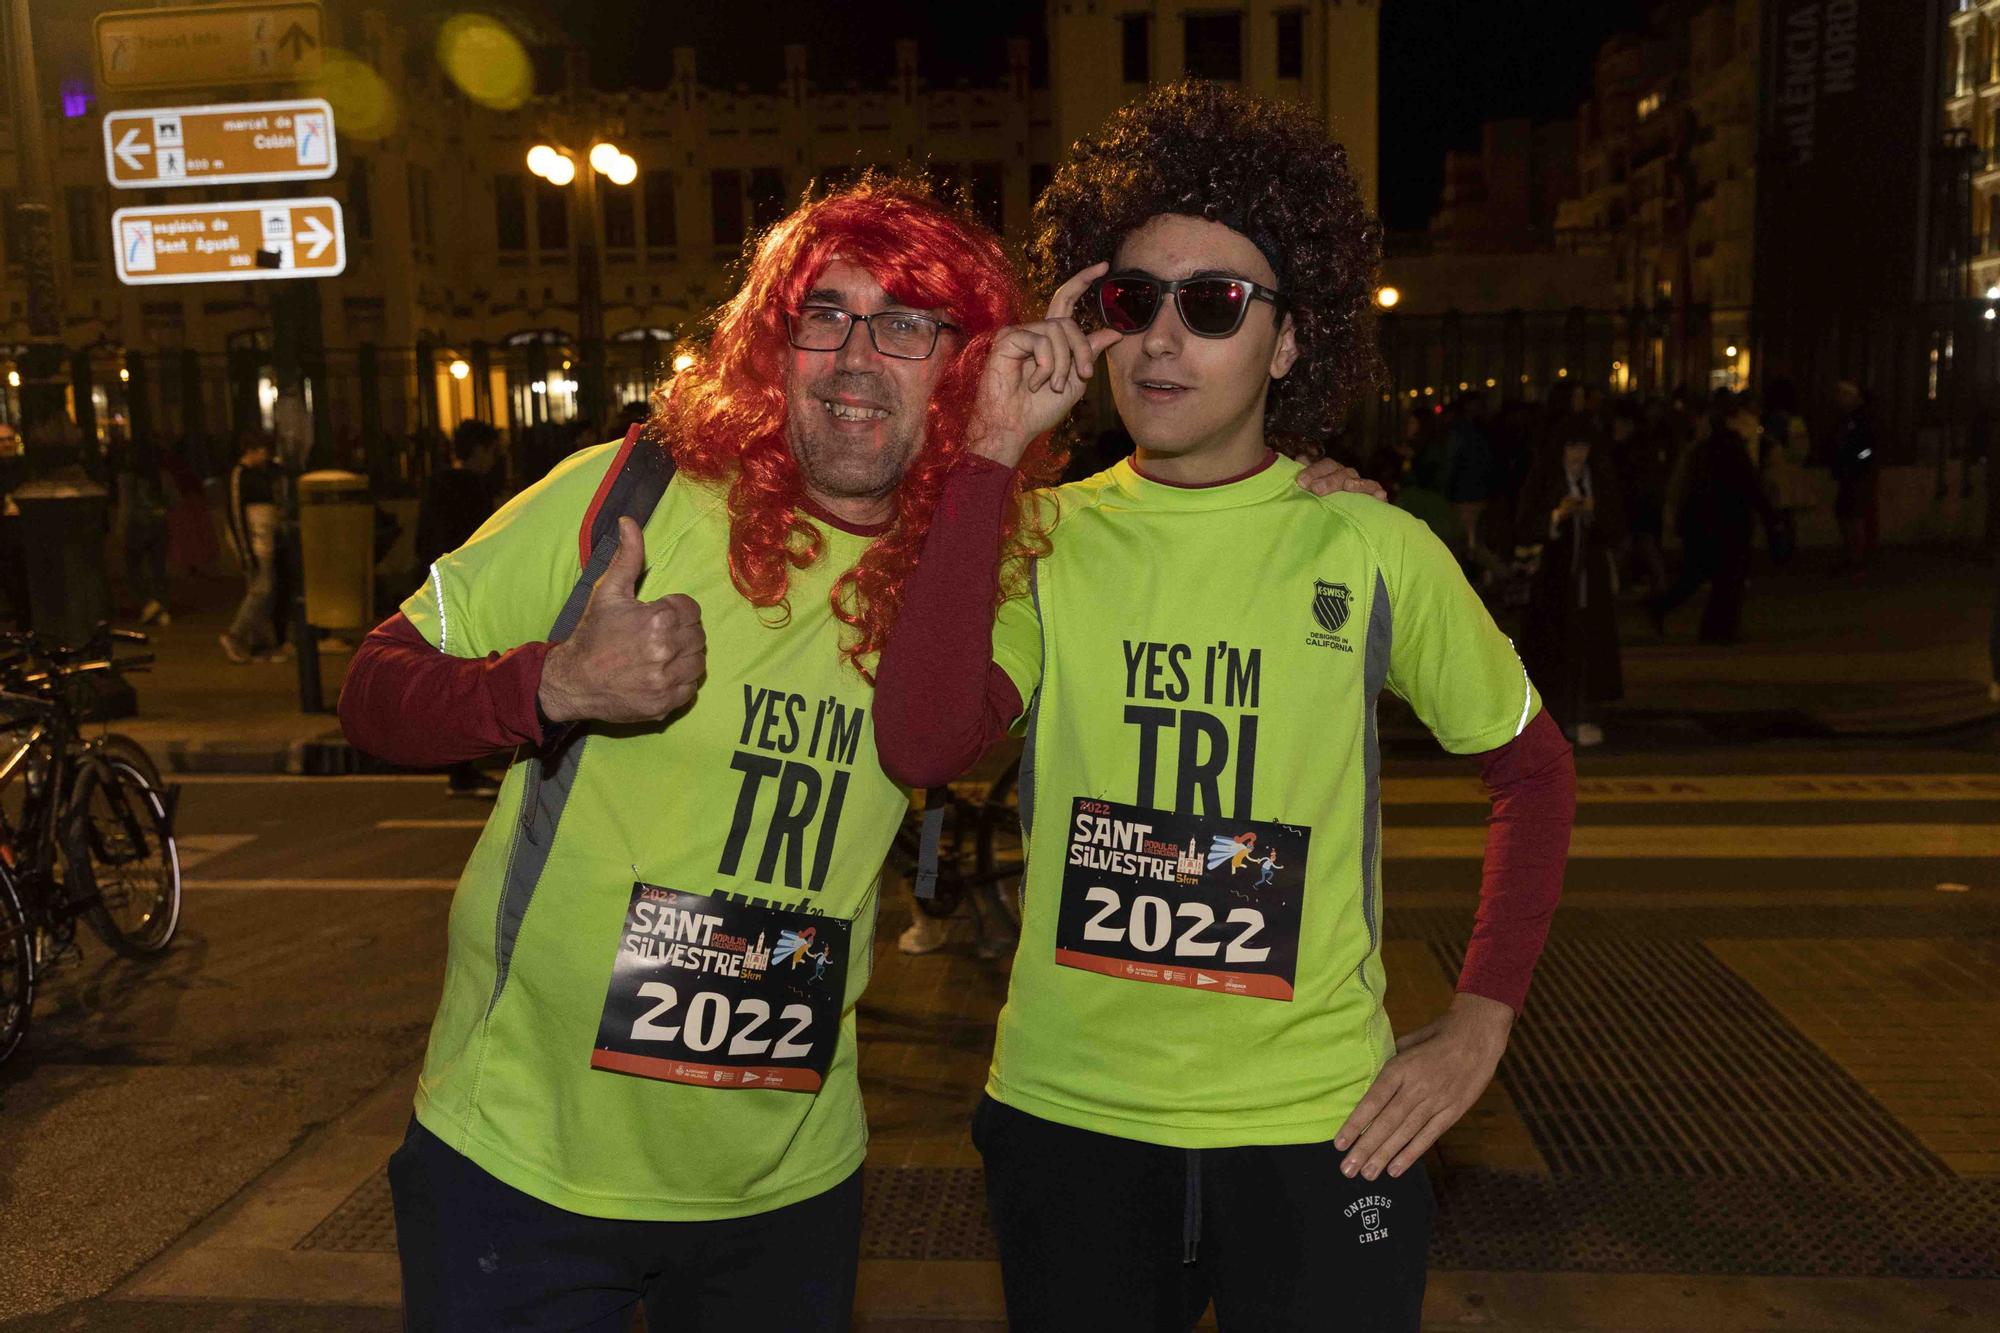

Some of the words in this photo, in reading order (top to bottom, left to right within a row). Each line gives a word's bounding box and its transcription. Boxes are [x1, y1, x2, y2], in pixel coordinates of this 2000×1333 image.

[212, 217, 229, 231] de
[156, 238, 188, 254] Sant
[1305, 638, 1354, 653] CALIFORNIA
[1310, 632, 1341, 642] DESIGNED
[1123, 640, 1192, 702] YES
[1204, 641, 1261, 708] I'M
[739, 684, 807, 754] YES
[808, 696, 865, 765] I'M
[1124, 705, 1259, 821] TRI
[1079, 800, 1112, 815] 2022
[718, 751, 851, 892] TRI
[1074, 814, 1152, 853] SANT
[640, 886, 677, 905] 2022
[631, 901, 724, 946] SANT
[1083, 887, 1271, 963] 2022
[630, 981, 814, 1059] 2022
[1343, 1195, 1392, 1218] ONENESS
[1365, 1213, 1377, 1225] SF
[1358, 1227, 1389, 1244] CREW
